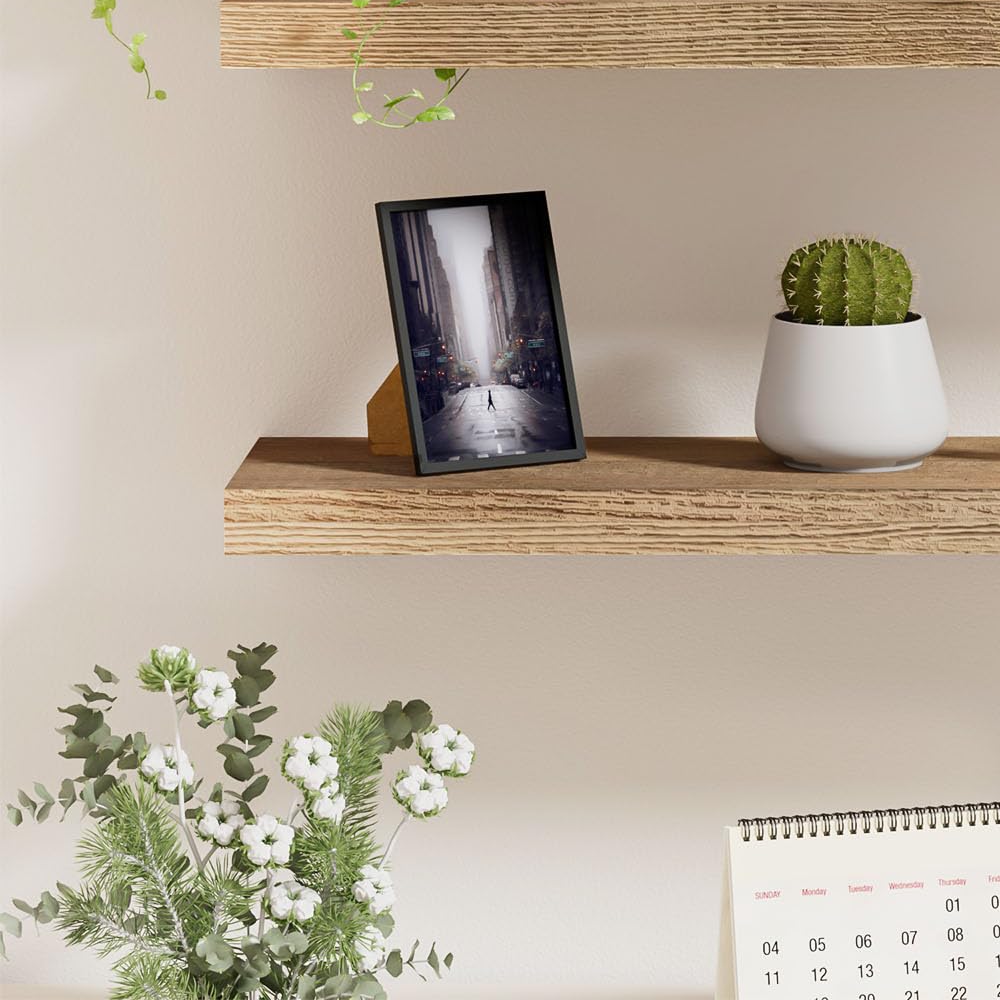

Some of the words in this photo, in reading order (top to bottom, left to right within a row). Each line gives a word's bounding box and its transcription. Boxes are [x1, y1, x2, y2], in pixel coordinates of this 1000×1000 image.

[755, 891, 781, 899] SUNDAY
[801, 888, 827, 897] Monday
[848, 885, 873, 893] Tuesday
[888, 881, 924, 891] Wednesday
[938, 878, 967, 887] Thursday
[945, 898, 960, 913] 01
[762, 941, 780, 956] 04
[809, 938, 826, 953] 05
[855, 934, 873, 949] 06
[902, 931, 917, 946] 07
[948, 928, 964, 943] 08
[765, 971, 779, 986] 11
[811, 967, 828, 982] 12
[858, 964, 874, 978] 13
[904, 960, 920, 975] 14
[950, 957, 966, 972] 15
[905, 990, 920, 1000] 21
[951, 986, 968, 1000] 22
